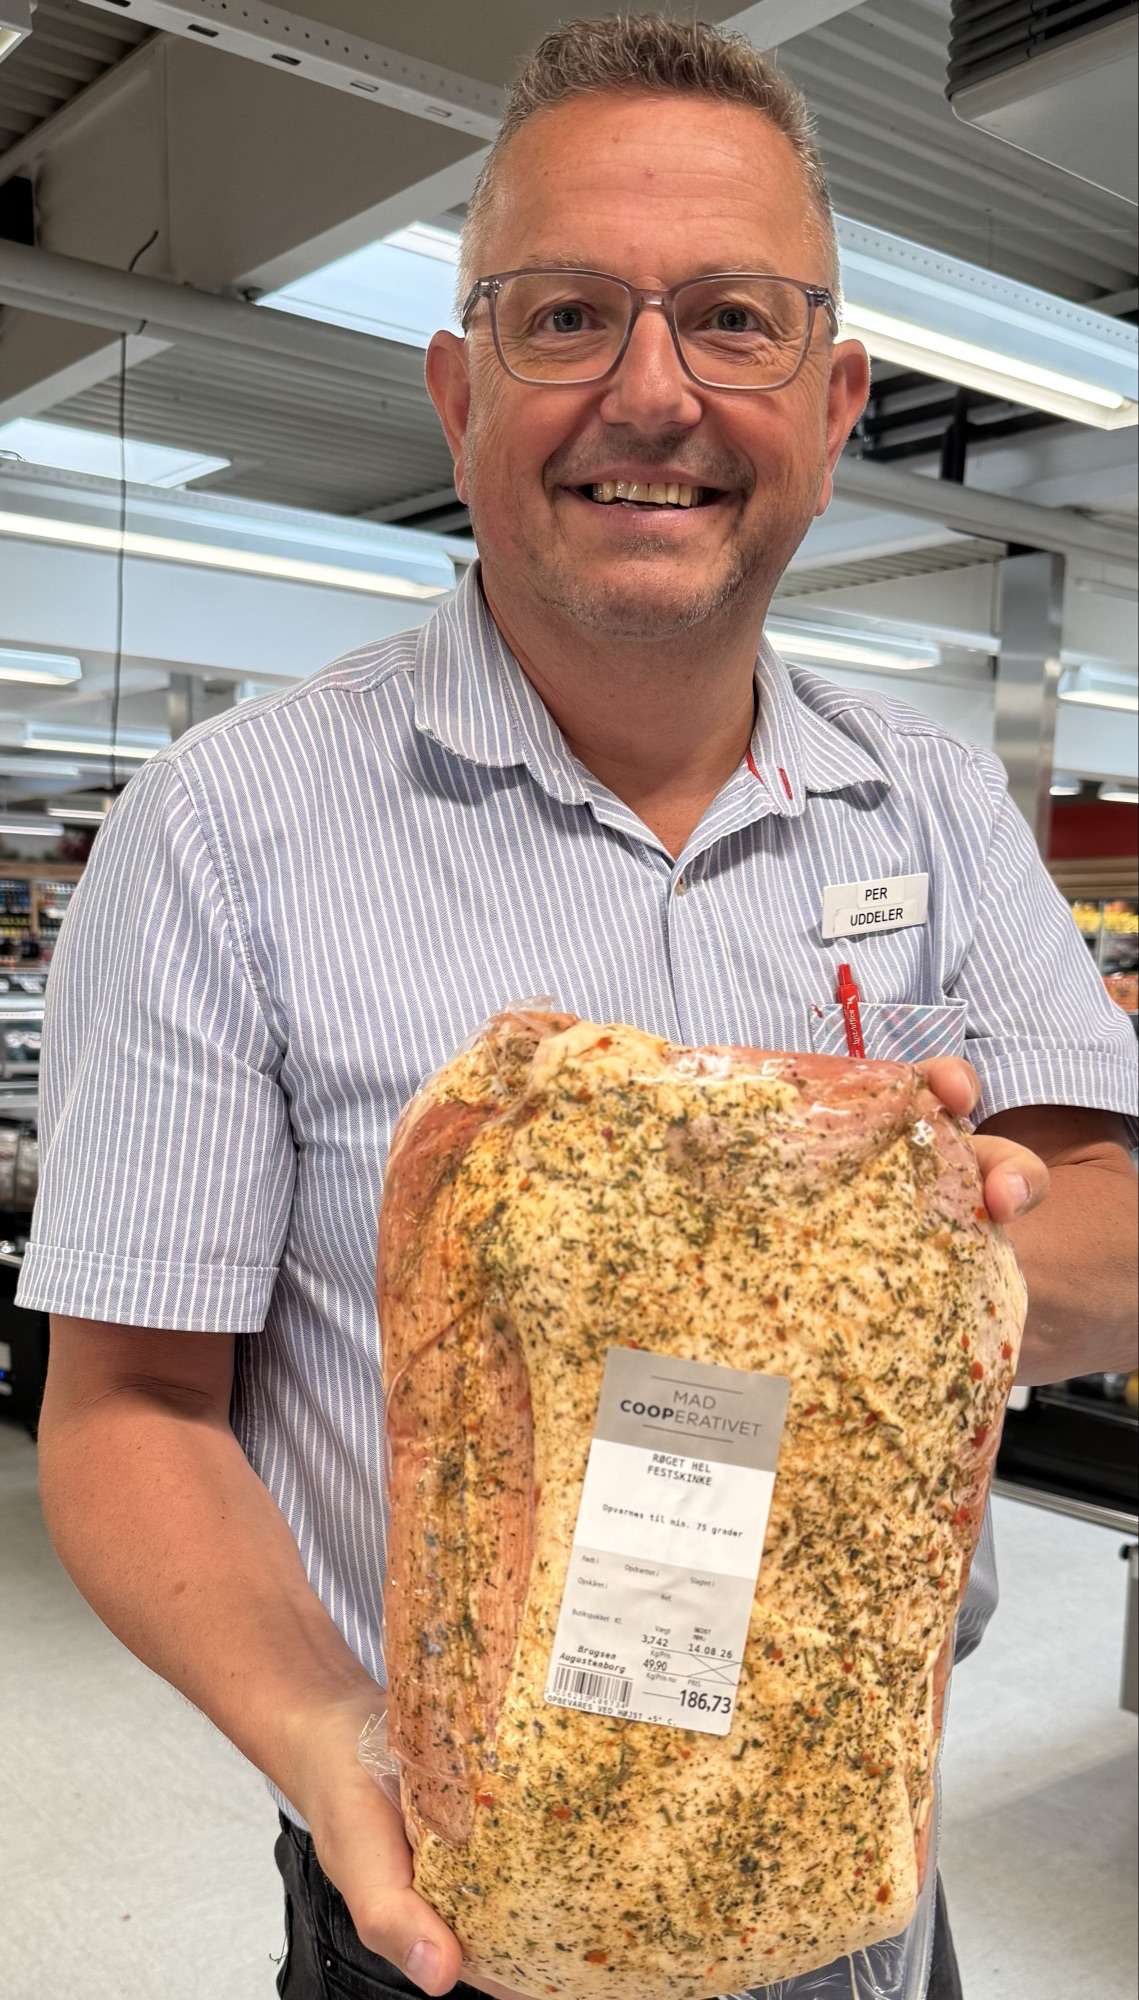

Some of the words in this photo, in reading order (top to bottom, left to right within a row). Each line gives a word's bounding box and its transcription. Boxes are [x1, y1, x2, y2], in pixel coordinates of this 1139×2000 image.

[865, 887, 887, 901] PER
[850, 908, 904, 927] UDDELER
[672, 1390, 716, 1410] MAD
[620, 1399, 762, 1437] COOPERATIVET
[652, 1453, 685, 1468] RØGET
[691, 1461, 712, 1474] HEL
[647, 1465, 713, 1486] FESTSKINKE
[650, 1513, 665, 1524] til
[696, 1522, 707, 1532] 75
[711, 1525, 743, 1538] grader
[577, 1644, 617, 1660] Brugsen
[559, 1652, 626, 1675] Augustenborg
[687, 1679, 701, 1688] PRIS
[547, 1695, 593, 1711] OPBEVARES
[597, 1704, 614, 1715] VED
[617, 1709, 643, 1720] HØJST
[679, 1689, 732, 1715] 186,73
